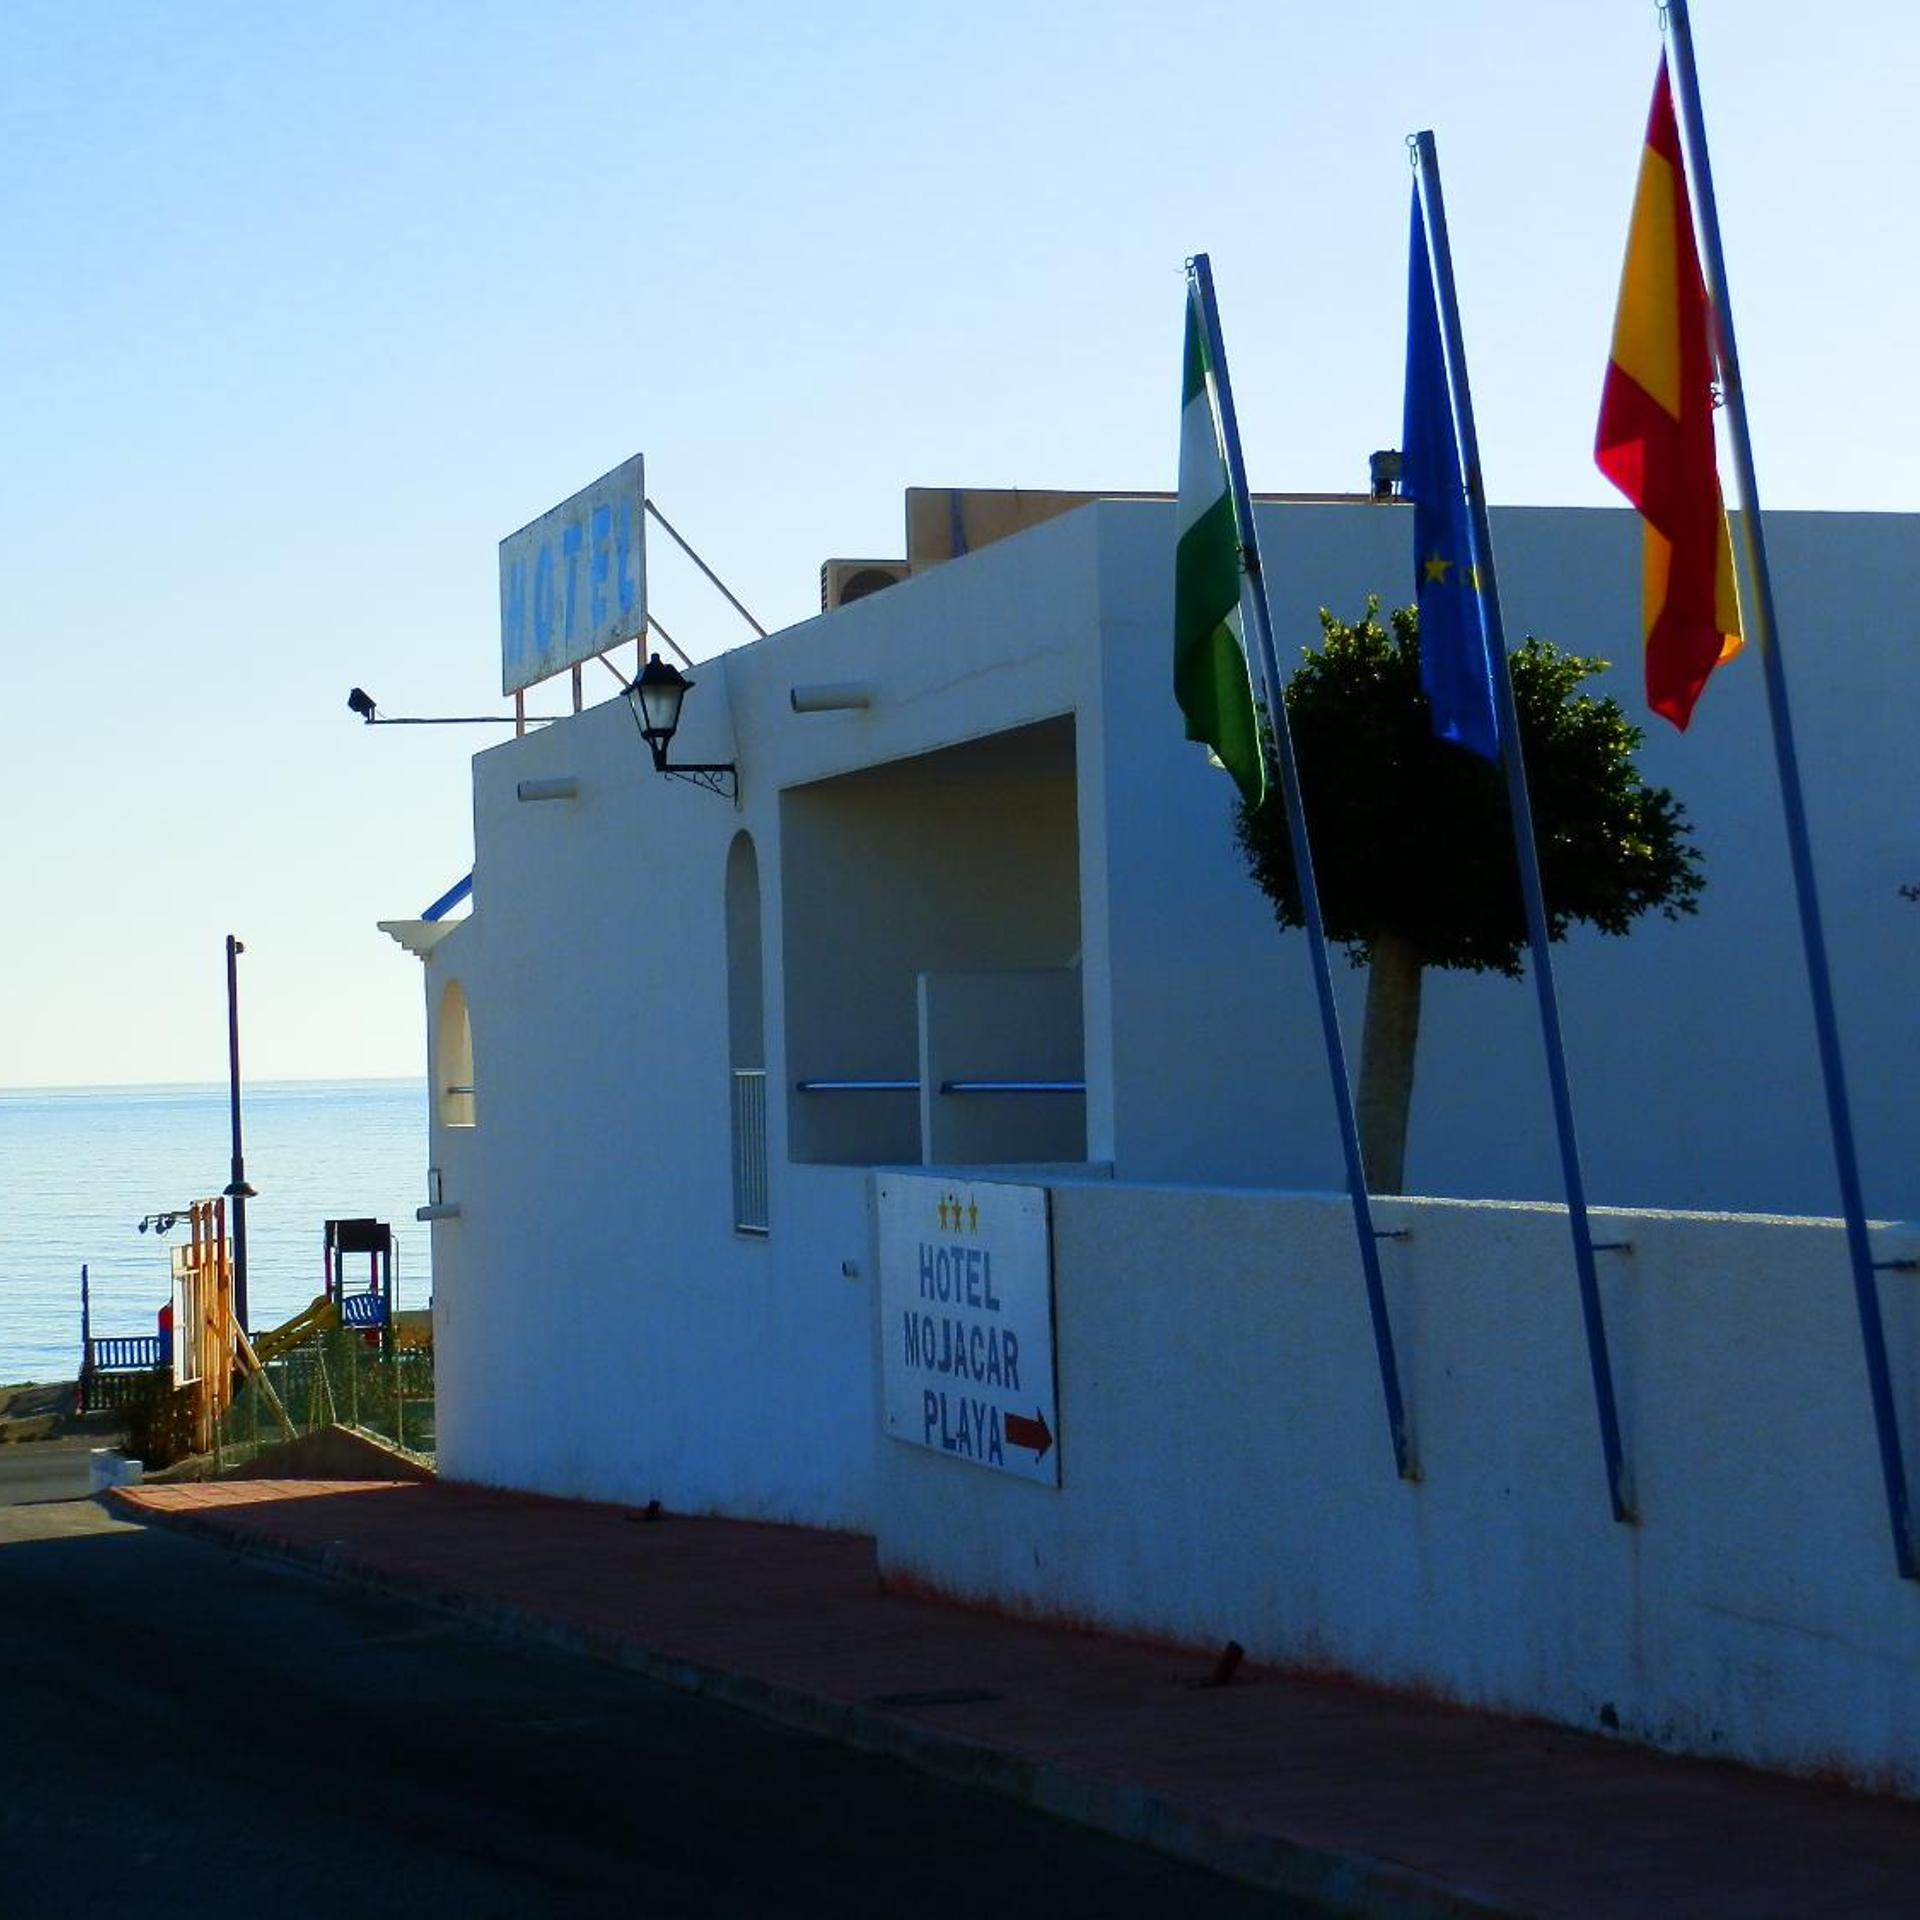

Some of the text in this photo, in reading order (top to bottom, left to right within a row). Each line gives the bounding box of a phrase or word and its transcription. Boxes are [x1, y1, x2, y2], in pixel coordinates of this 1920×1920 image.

[919, 1242, 1000, 1311] HOTEL
[904, 1311, 1020, 1391] MOJACAR
[924, 1389, 1004, 1466] PLAYA
